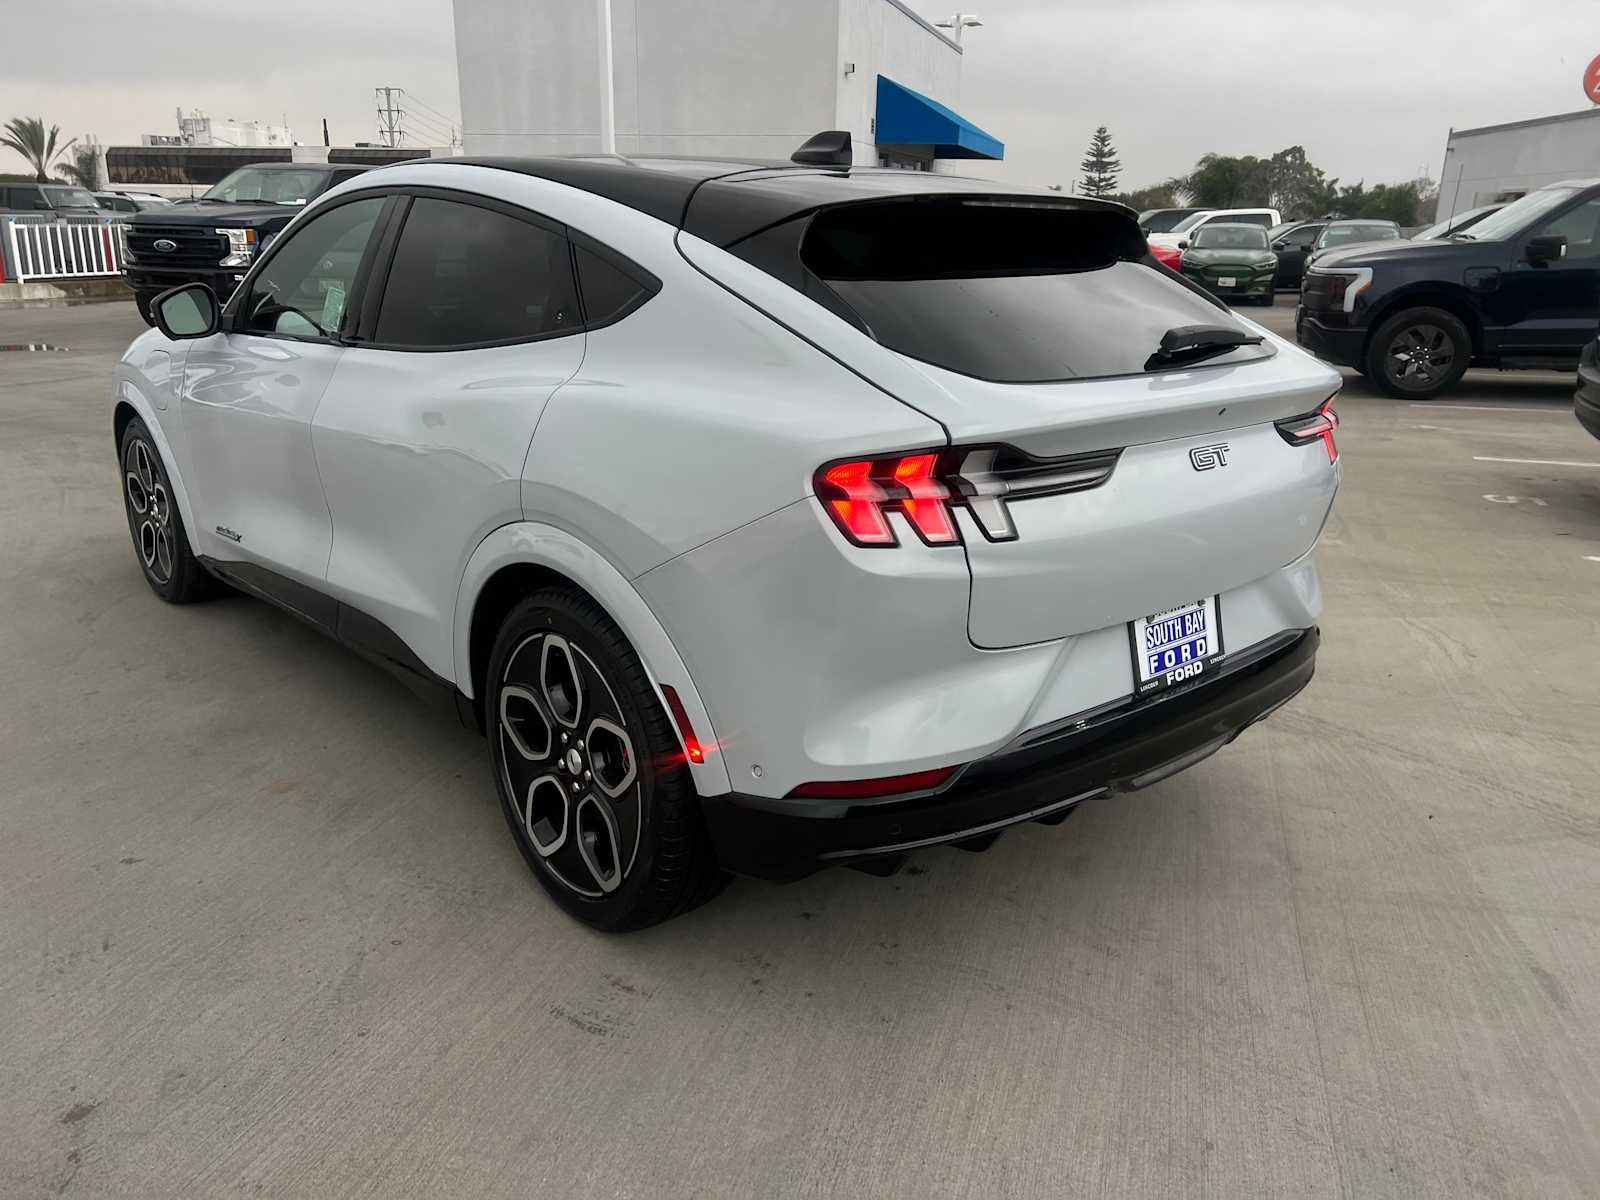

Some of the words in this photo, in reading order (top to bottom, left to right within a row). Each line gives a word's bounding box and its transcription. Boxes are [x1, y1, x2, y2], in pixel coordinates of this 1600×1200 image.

[1189, 442, 1230, 472] GT
[1146, 618, 1183, 649] SOUTH
[1185, 610, 1205, 635] BAY
[1149, 639, 1206, 673] FORD
[1166, 661, 1203, 685] FORD
